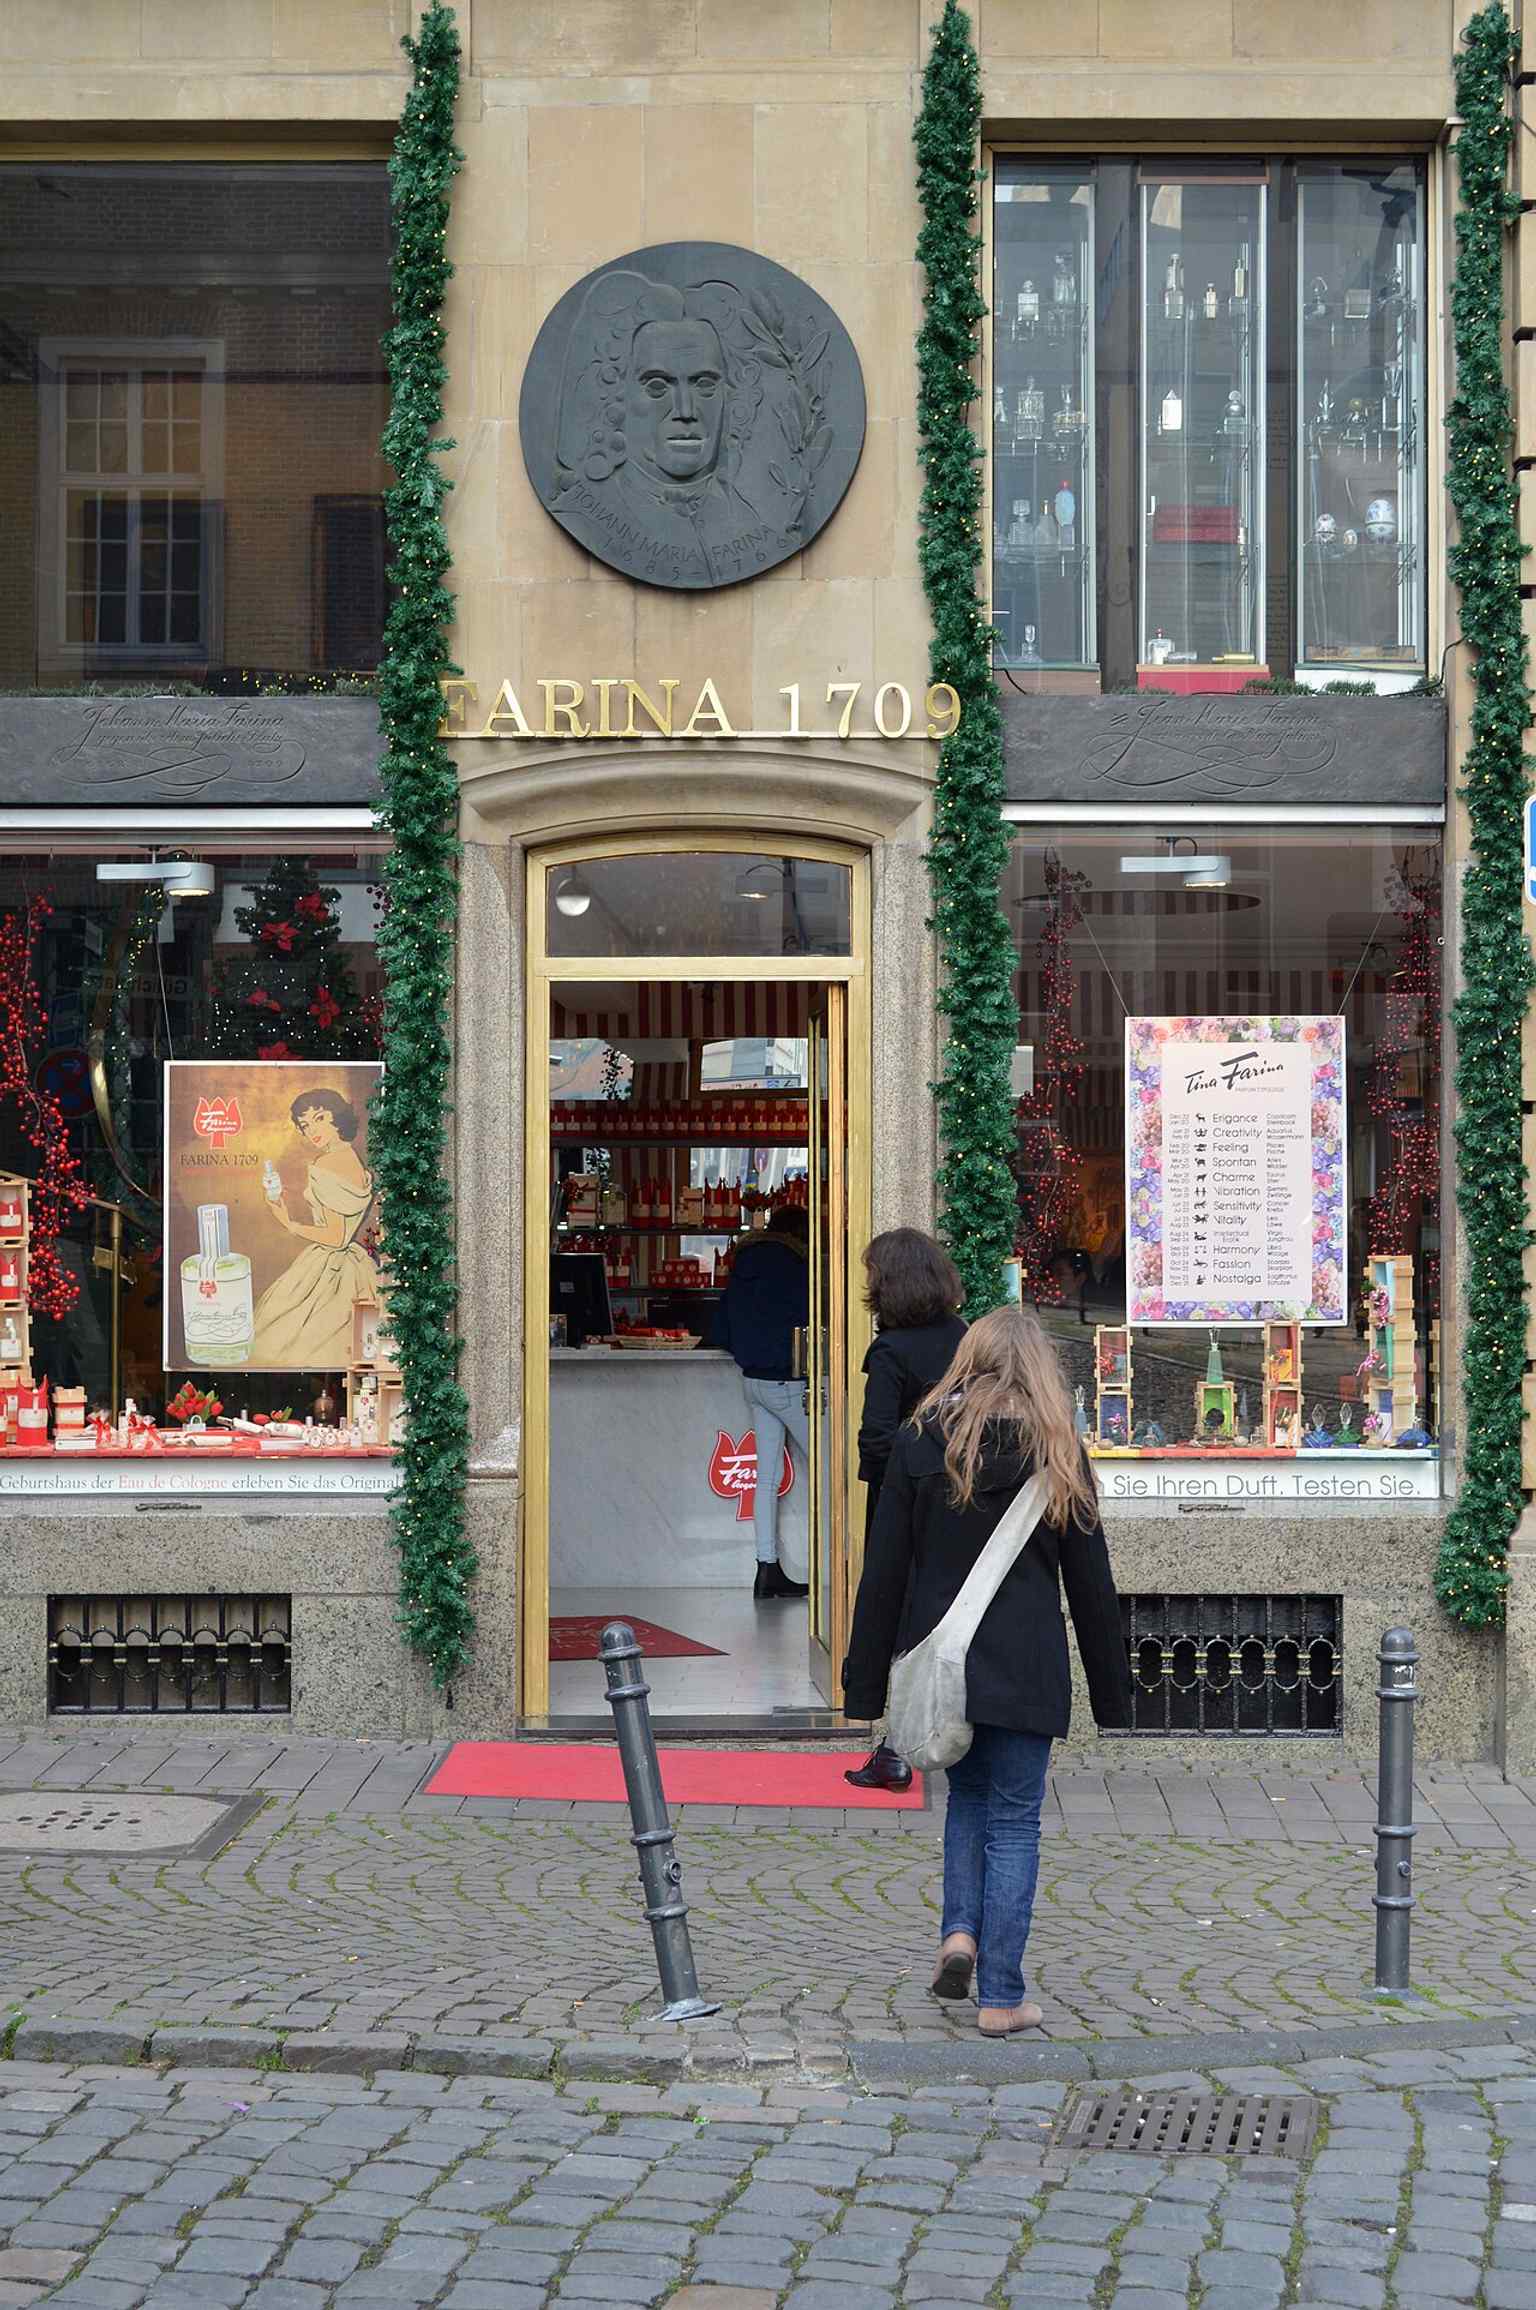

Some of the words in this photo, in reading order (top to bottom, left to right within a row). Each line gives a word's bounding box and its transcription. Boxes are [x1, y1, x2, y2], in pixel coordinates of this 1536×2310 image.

[639, 534, 698, 562] MARIA
[711, 524, 776, 562] FARINA
[439, 678, 739, 739] FARINA
[778, 681, 962, 740] 1709
[1184, 1070, 1217, 1094] Tina
[1219, 1051, 1284, 1091] Farina
[1212, 1127, 1263, 1139] Creativity
[1212, 1143, 1249, 1154] Feeling
[181, 1153, 230, 1167] FARINA
[232, 1153, 259, 1167] 1709
[1212, 1157, 1257, 1168] Spontan
[1212, 1172, 1256, 1182] Charme
[1213, 1200, 1262, 1212] Sensitivity
[1213, 1215, 1247, 1226] Vitality
[1212, 1244, 1262, 1255] Harmony
[0, 1474, 88, 1489] Geburtshaus
[91, 1474, 114, 1489] der
[119, 1475, 145, 1489] Eau
[149, 1474, 166, 1489] de
[169, 1474, 228, 1491] Cologne
[232, 1474, 283, 1489] erleben
[287, 1474, 309, 1489] Sie
[313, 1474, 337, 1489] das
[1113, 1475, 1148, 1496] Sie
[1156, 1475, 1218, 1496] Ihren
[1226, 1475, 1284, 1496] Duft.
[1292, 1475, 1372, 1496] Testen
[1379, 1475, 1421, 1496] Sie.
